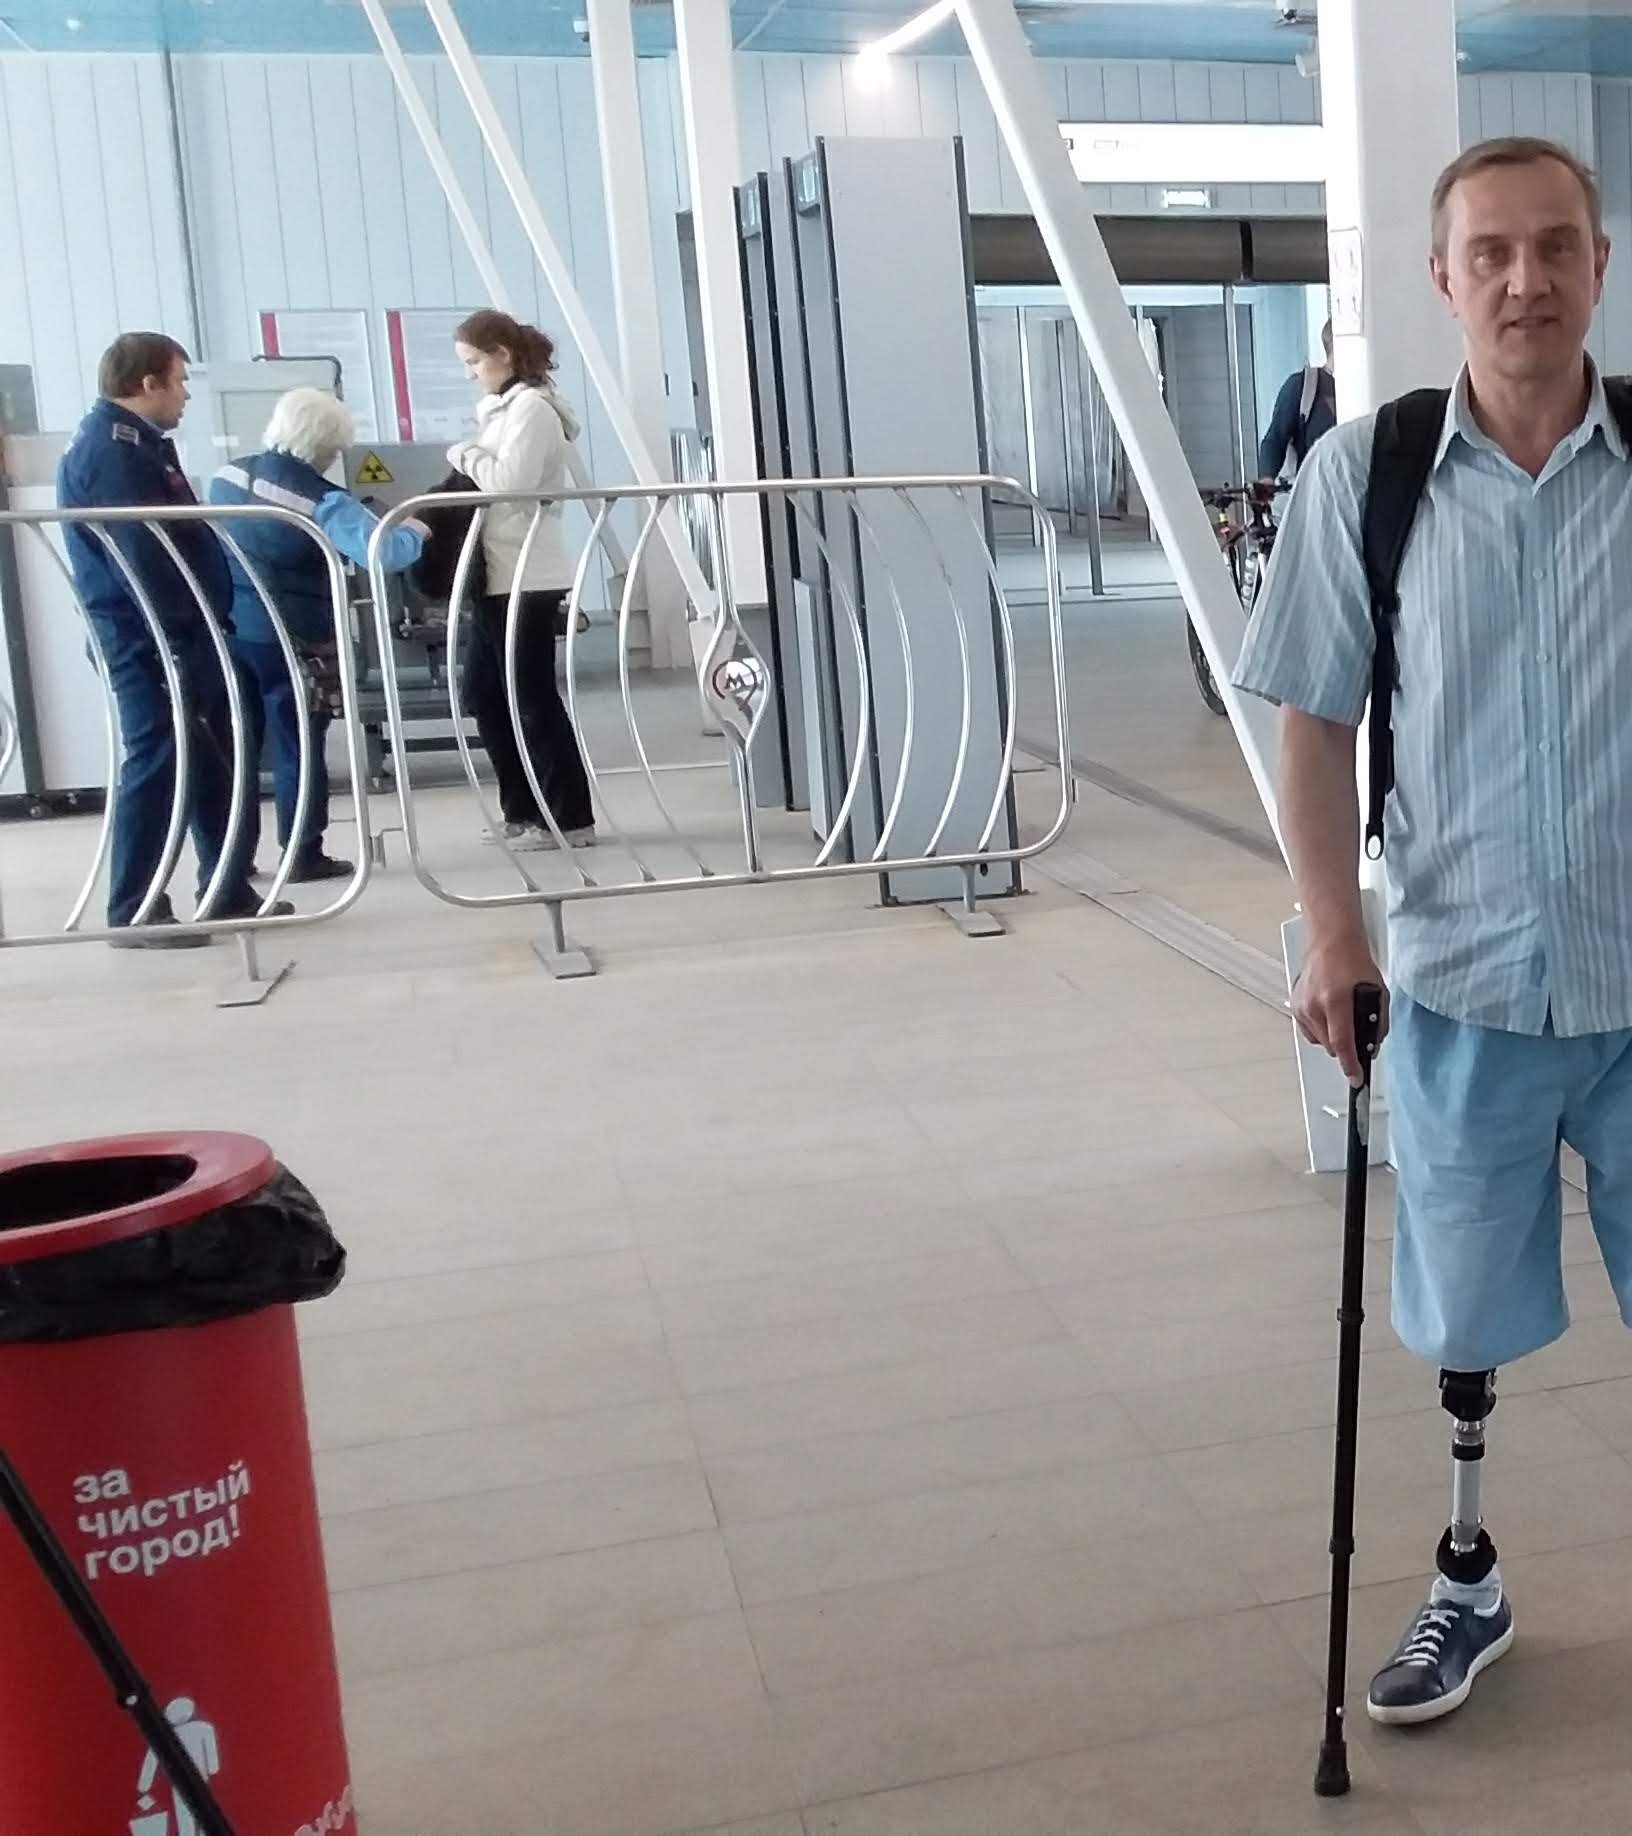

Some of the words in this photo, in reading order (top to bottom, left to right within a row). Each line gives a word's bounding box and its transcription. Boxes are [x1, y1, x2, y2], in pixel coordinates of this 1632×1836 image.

[72, 1467, 131, 1504] за
[78, 1459, 252, 1539] чистый
[84, 1504, 242, 1580] город!
